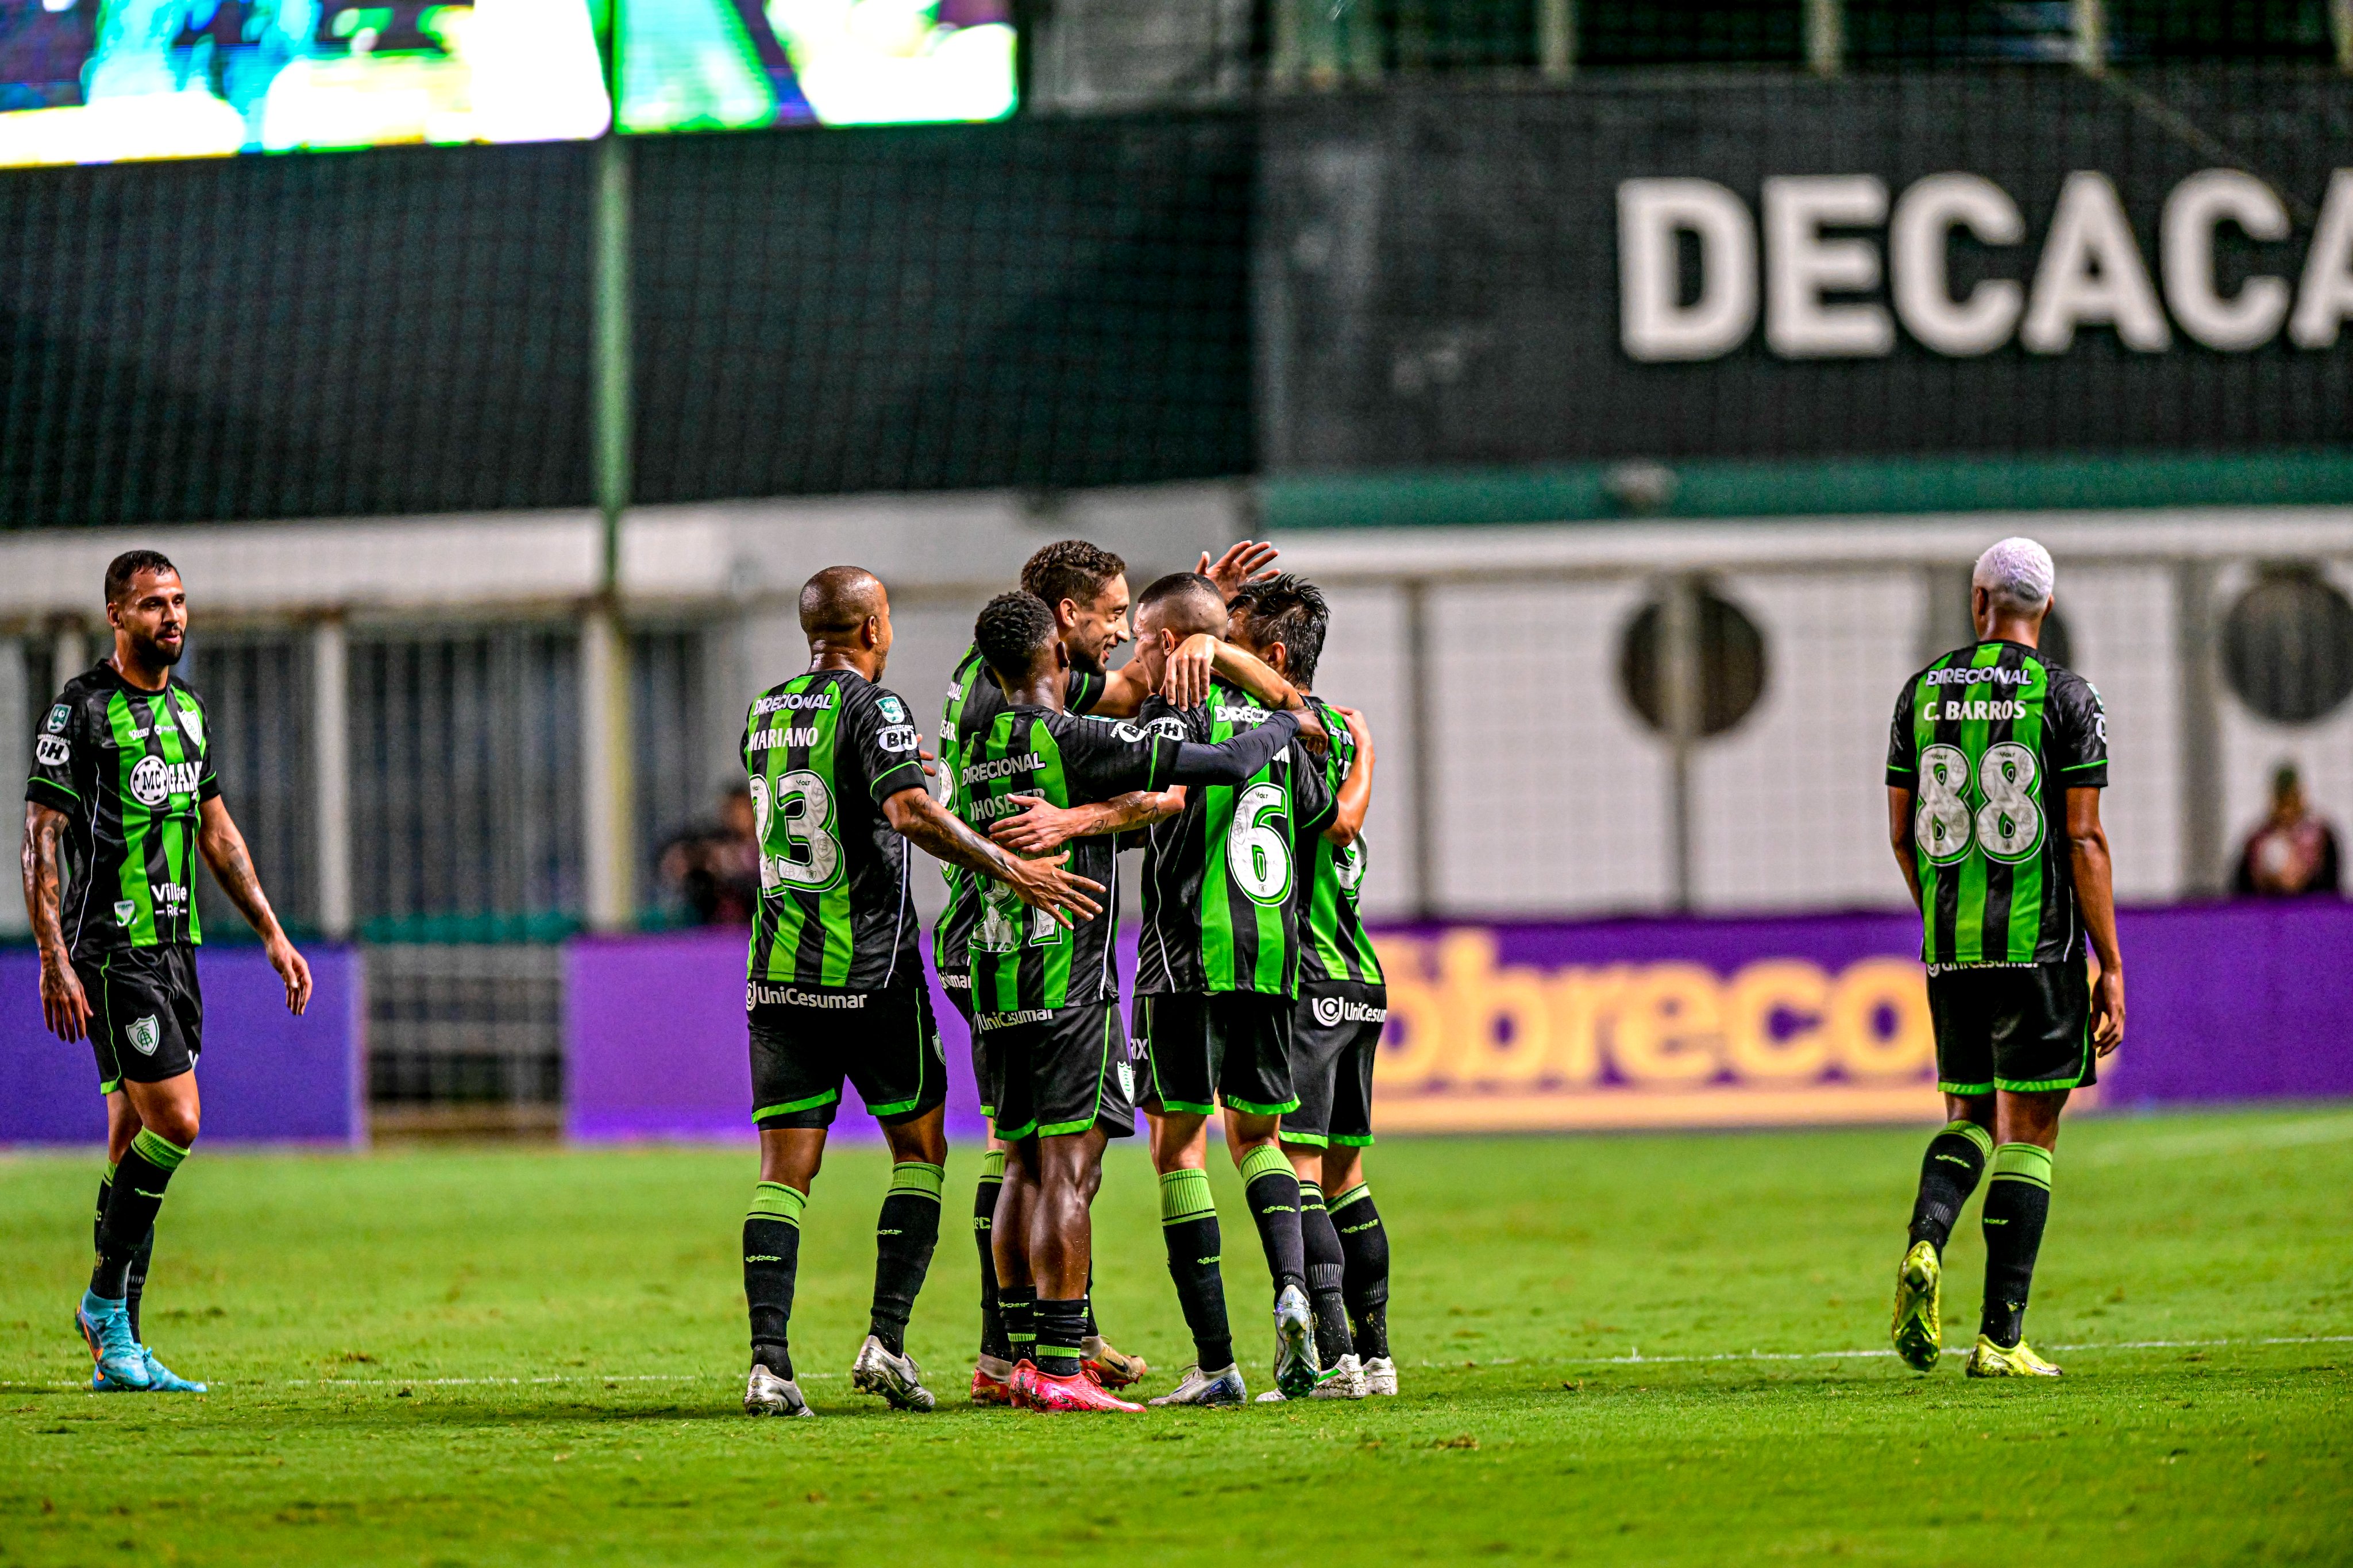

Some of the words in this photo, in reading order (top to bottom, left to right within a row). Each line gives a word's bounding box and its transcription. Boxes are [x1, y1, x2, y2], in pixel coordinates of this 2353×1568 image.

[1926, 666, 2032, 686] DIRECIONAL
[753, 694, 834, 717] DIRECIONAL
[1923, 702, 1941, 721] C.
[1945, 700, 2027, 721] BARROS
[748, 727, 818, 752] MARIANO
[886, 731, 913, 748] BH
[142, 770, 161, 790] MC
[962, 752, 1046, 787] DIRECIONAL
[1915, 741, 2046, 867] 88
[1227, 782, 1293, 907] 6
[758, 986, 868, 1009] UniCesumar
